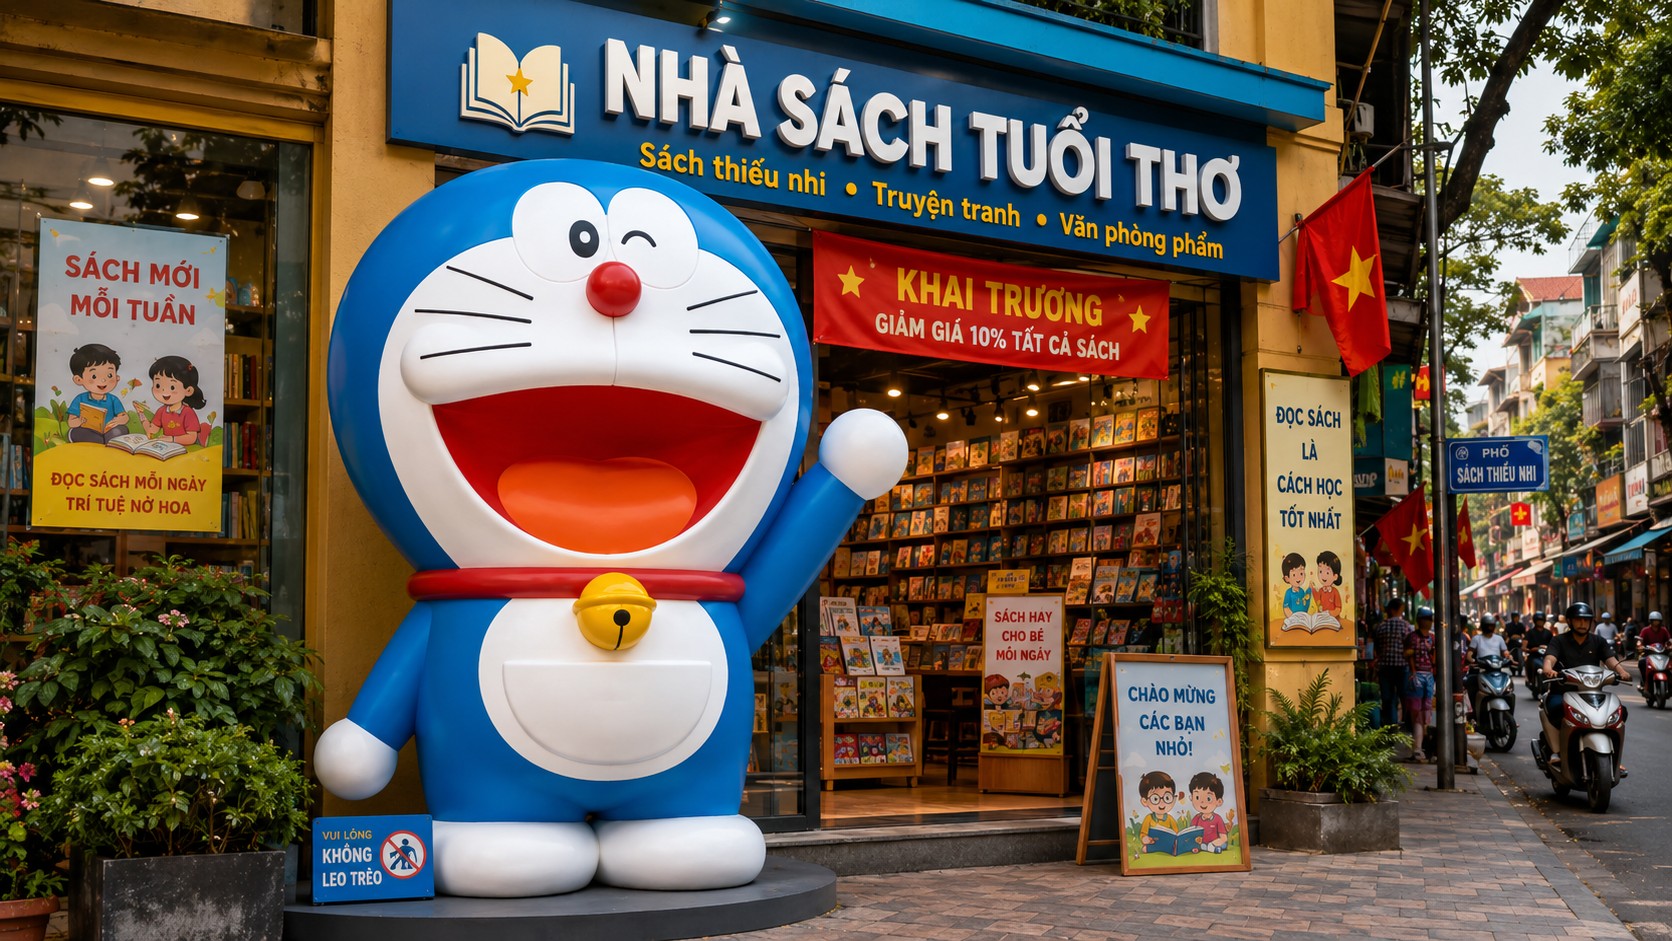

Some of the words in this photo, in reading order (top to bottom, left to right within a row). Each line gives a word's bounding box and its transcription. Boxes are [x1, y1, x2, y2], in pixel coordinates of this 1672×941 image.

[604, 37, 762, 139] NHÀ
[776, 67, 952, 173] SÁCH
[968, 106, 1112, 200] TUỔI
[1125, 142, 1242, 222] THƠ
[639, 142, 704, 176] Sách
[713, 155, 779, 190] thiếu
[788, 168, 826, 197] nhi
[872, 181, 954, 220] Truyện
[962, 198, 1021, 228] tranh
[1060, 212, 1098, 240] Văn
[1105, 220, 1167, 255] phòng
[1172, 230, 1224, 260] phẩm
[65, 250, 140, 283] SÁCH
[150, 260, 199, 290] MỚI
[70, 286, 119, 319] MỖI
[127, 293, 195, 325] TUẦN
[897, 266, 974, 312] KHAI
[985, 280, 1103, 327] TRƯƠNG
[875, 310, 925, 340] GIẢM
[932, 317, 964, 344] GIÁ
[970, 325, 1007, 349] 10%
[1012, 325, 1044, 353] TẤT
[1049, 331, 1071, 357] CẢ
[1077, 334, 1120, 361] SÁCH
[1276, 406, 1304, 429] ĐỌC
[1308, 404, 1341, 428] SÁCH
[1302, 438, 1318, 460] LÀ
[1482, 444, 1510, 459] PHỐ
[51, 472, 85, 490] ĐỌC
[89, 470, 130, 489] SÁCH
[135, 470, 162, 490] MỖI
[167, 475, 207, 492] NGÀY
[1519, 465, 1537, 482] NHI
[1277, 471, 1312, 494] CÁCH
[1316, 478, 1343, 500] HỌC
[66, 494, 90, 511] TRÍ
[96, 495, 126, 515] TUỆ
[159, 500, 191, 515] HOA
[1280, 504, 1304, 528] TỐT
[1308, 506, 1342, 530] NHẤT
[994, 608, 1026, 622] SÁCH
[1002, 630, 1026, 642] CHO
[1030, 627, 1044, 642] BÉ
[1128, 683, 1169, 703] CHÀO
[1173, 684, 1216, 704] MỪNG
[1139, 710, 1170, 731] CÁC
[1174, 715, 1205, 734] BẠN
[1155, 736, 1193, 756] NHỎ!
[323, 831, 341, 841] VUI
[323, 843, 372, 863] KHÔNG
[322, 871, 347, 887] LEO
[350, 867, 383, 886] TRÈO
